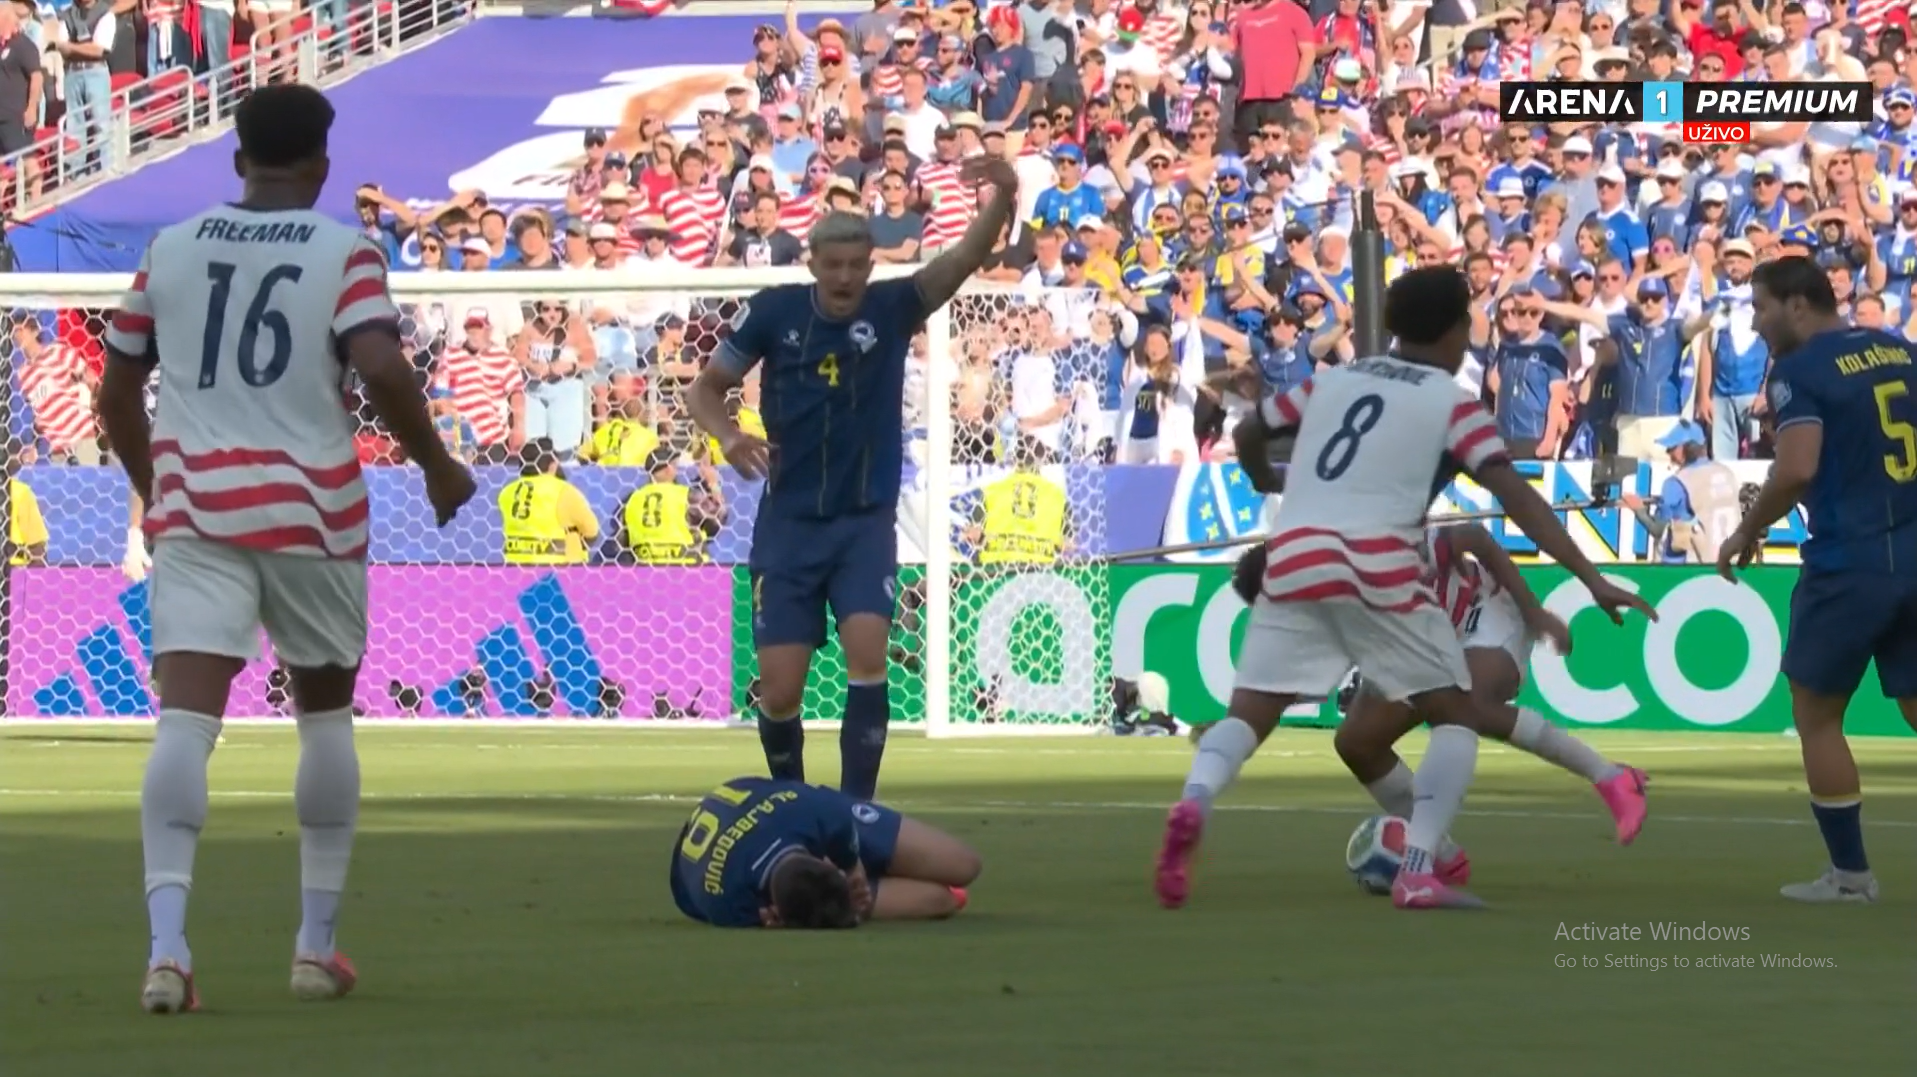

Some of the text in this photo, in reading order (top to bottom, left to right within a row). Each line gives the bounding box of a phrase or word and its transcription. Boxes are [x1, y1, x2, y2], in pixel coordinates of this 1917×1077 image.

[195, 217, 317, 244] FREEMAN
[197, 260, 304, 391] 16
[817, 352, 840, 387] 4
[1314, 393, 1386, 482] 8
[1872, 379, 1917, 485] 5
